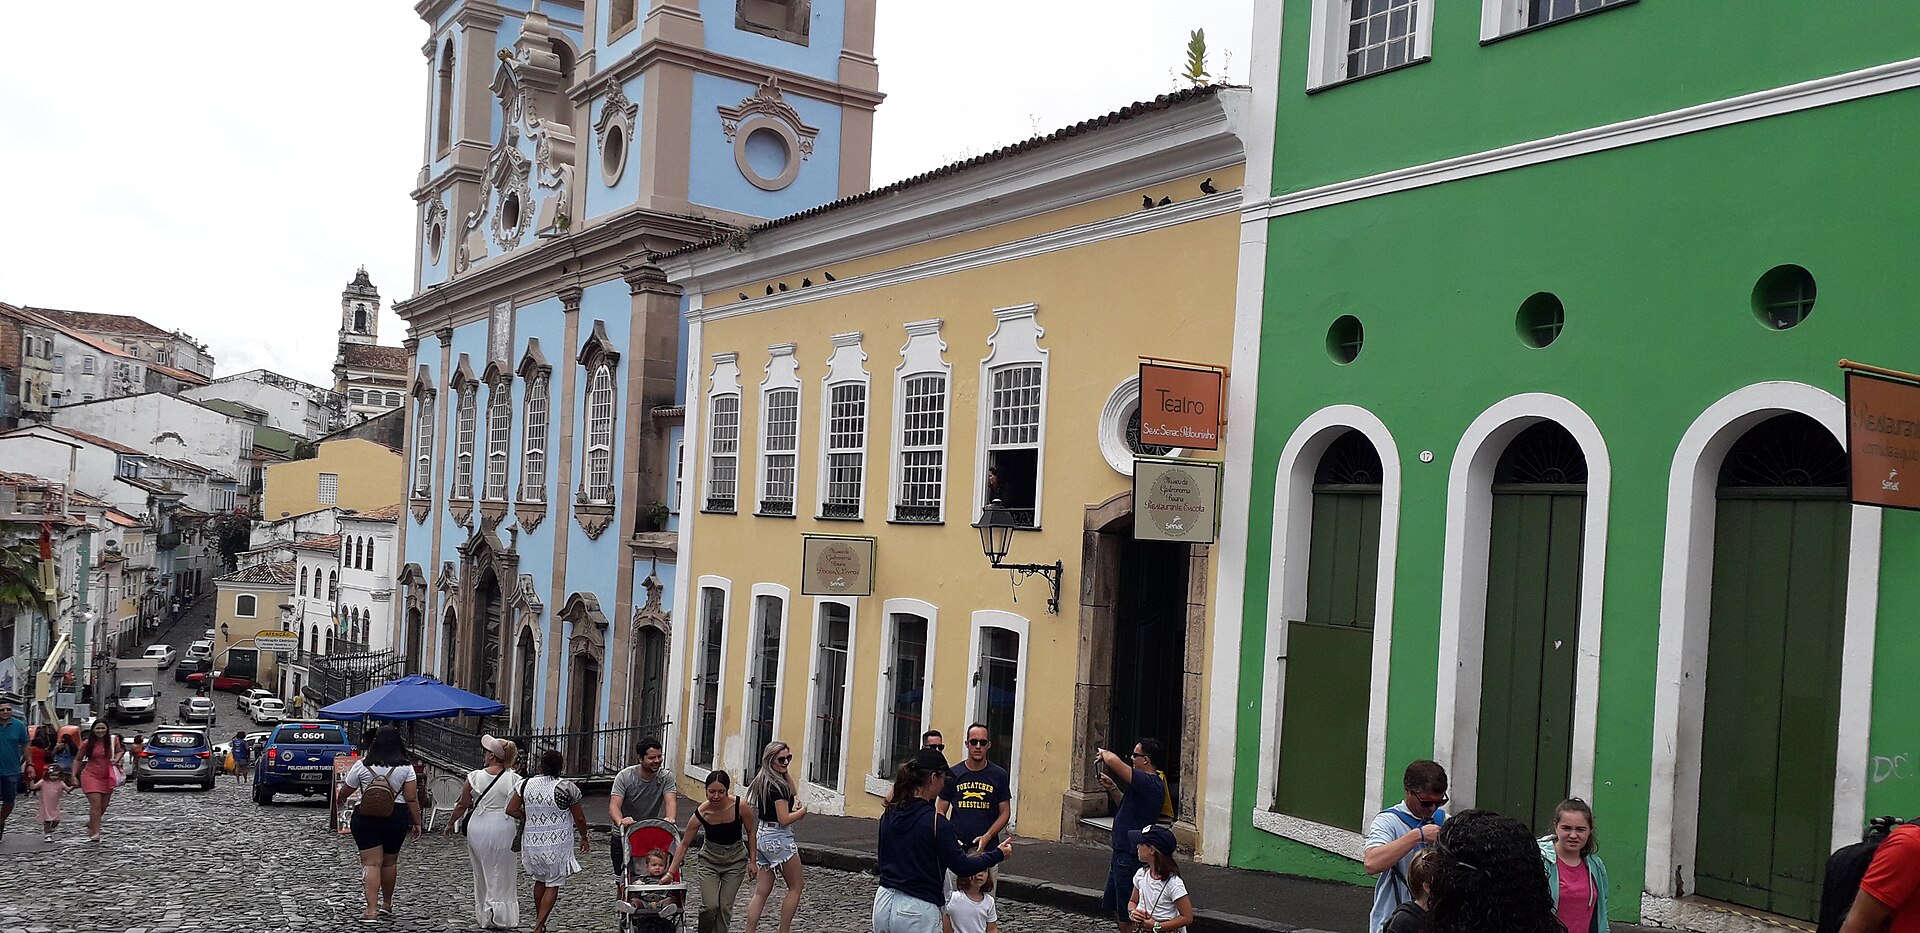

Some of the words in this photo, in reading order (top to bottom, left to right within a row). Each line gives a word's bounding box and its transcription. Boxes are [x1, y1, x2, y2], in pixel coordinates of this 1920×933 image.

[1160, 424, 1180, 437] Senac
[1180, 425, 1216, 440] Pelourinho
[1881, 479, 1900, 491] Senac
[1144, 499, 1183, 512] Restaurante
[1183, 501, 1205, 513] Escola
[1165, 522, 1184, 531] Senac
[160, 736, 195, 744] 8.1807
[293, 732, 325, 740] 6.0601
[956, 781, 994, 793] FOXCATCHER
